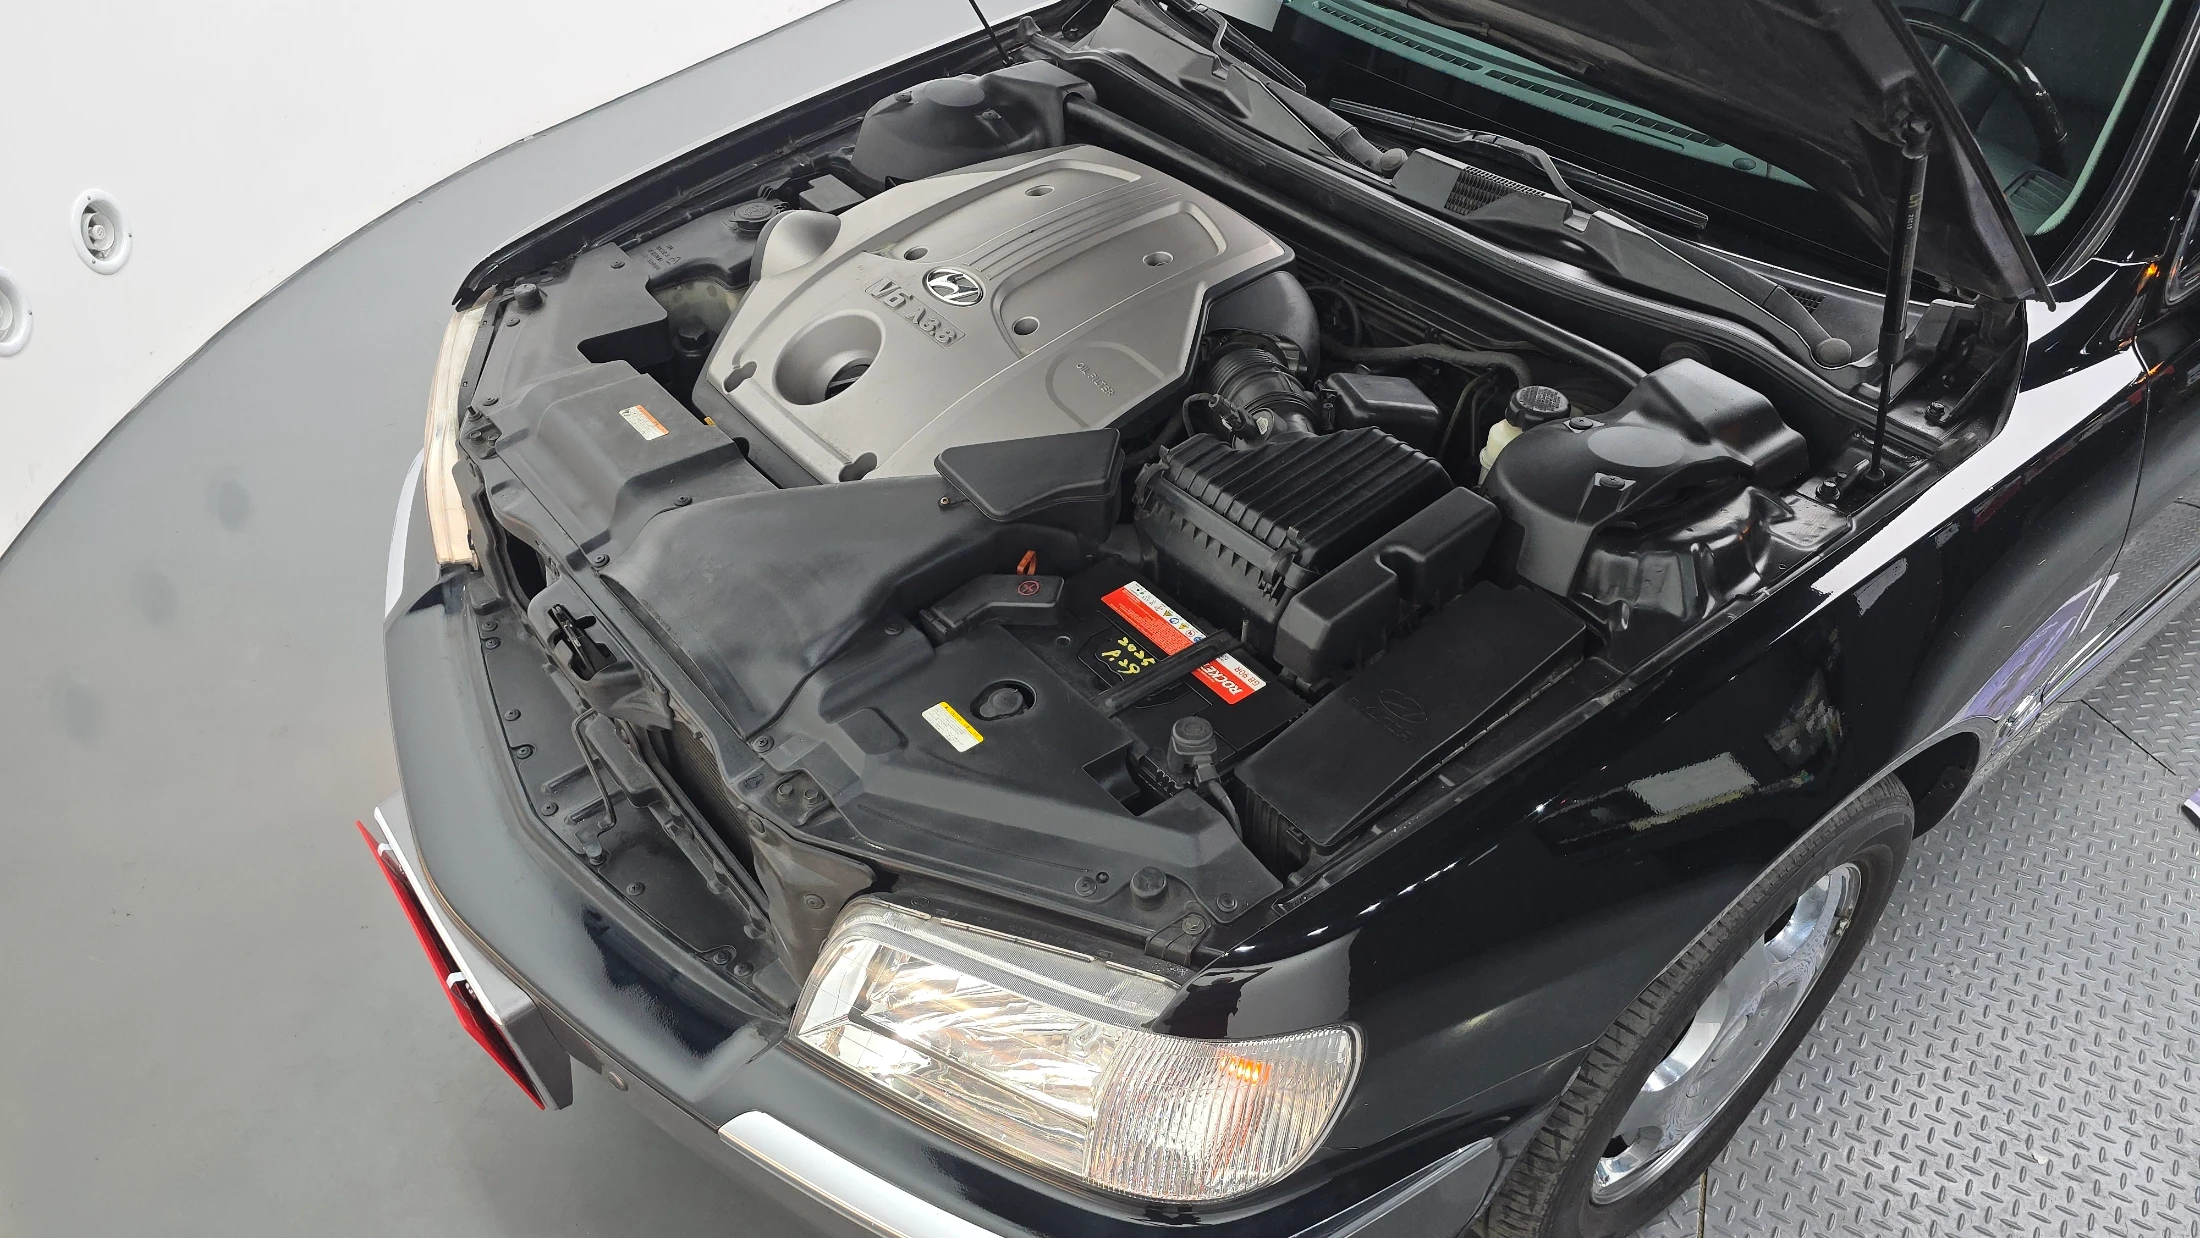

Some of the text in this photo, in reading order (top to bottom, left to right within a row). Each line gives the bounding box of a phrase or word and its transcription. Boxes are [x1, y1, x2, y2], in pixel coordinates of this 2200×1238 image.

[871, 280, 907, 308] V6
[1076, 362, 1115, 397] OIL FILTER
